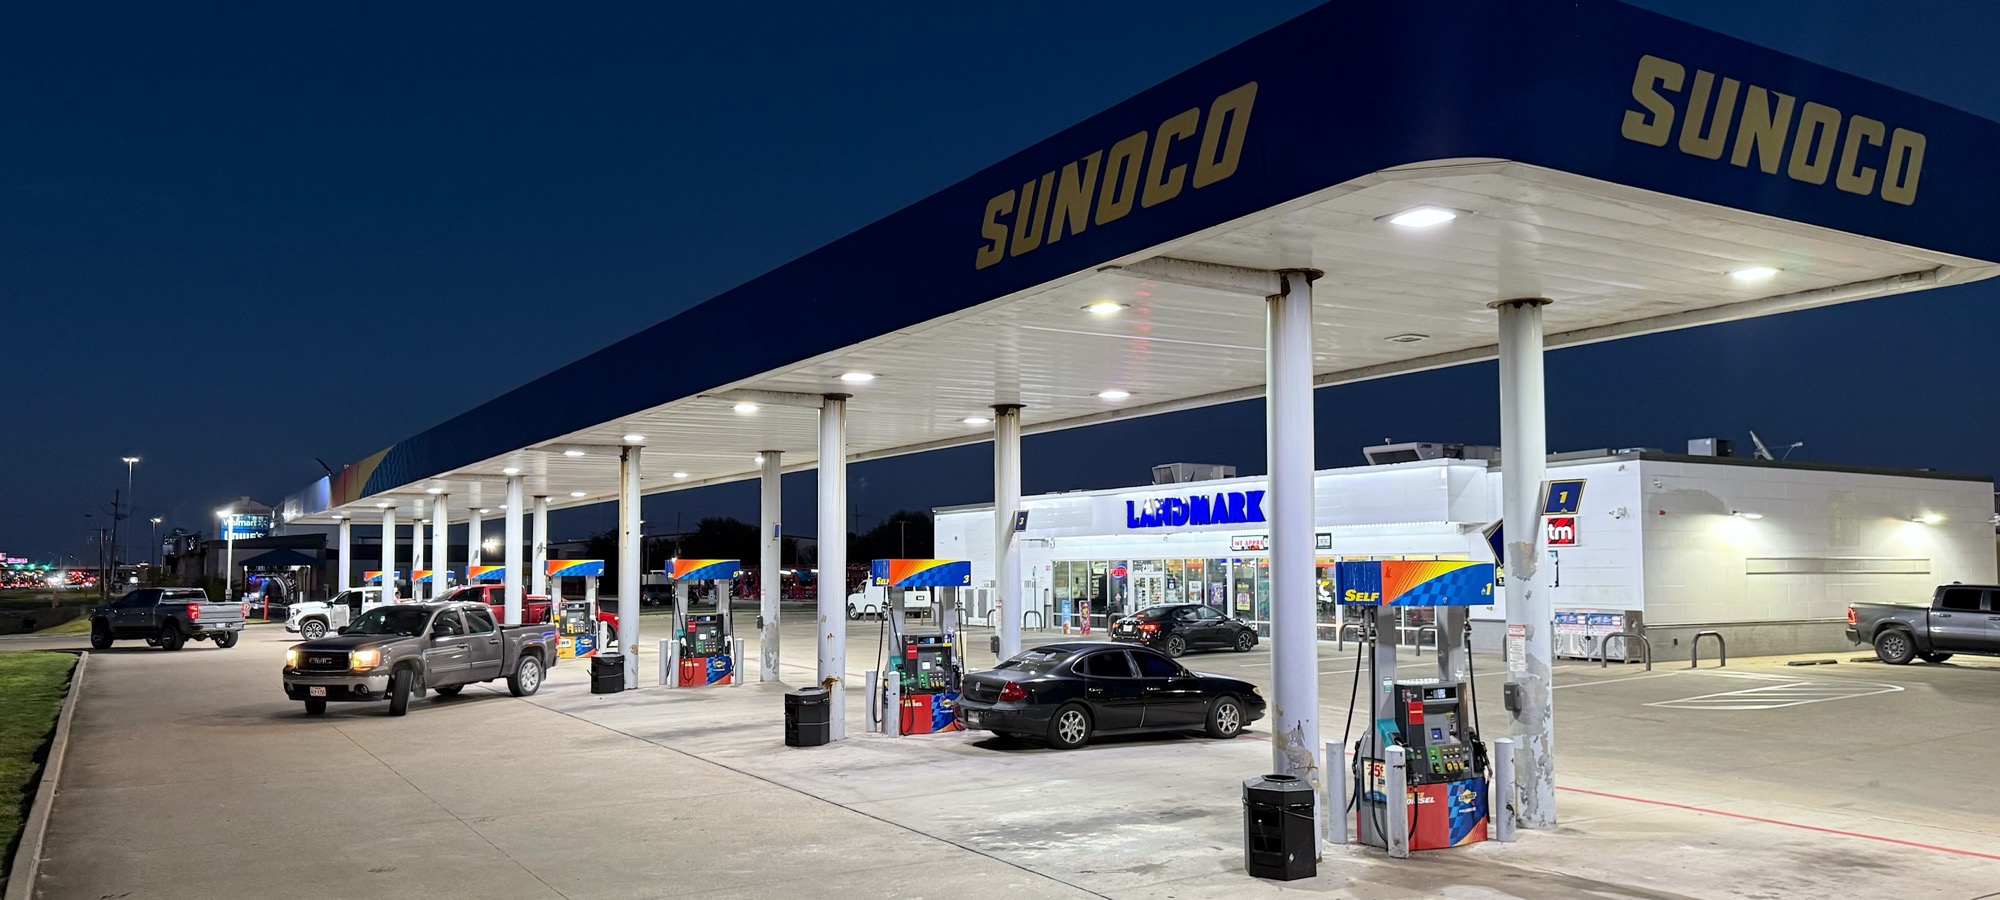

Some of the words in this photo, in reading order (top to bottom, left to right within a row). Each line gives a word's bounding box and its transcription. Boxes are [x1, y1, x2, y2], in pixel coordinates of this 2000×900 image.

[1621, 54, 1927, 206] SUNOCO
[975, 81, 1258, 270] SUNOCO
[1559, 491, 1568, 504] 1
[1126, 490, 1266, 528] LANDMARK
[1019, 517, 1025, 526] 3
[963, 575, 970, 584] 3
[1344, 589, 1380, 602] SELF
[1486, 583, 1493, 596] 1
